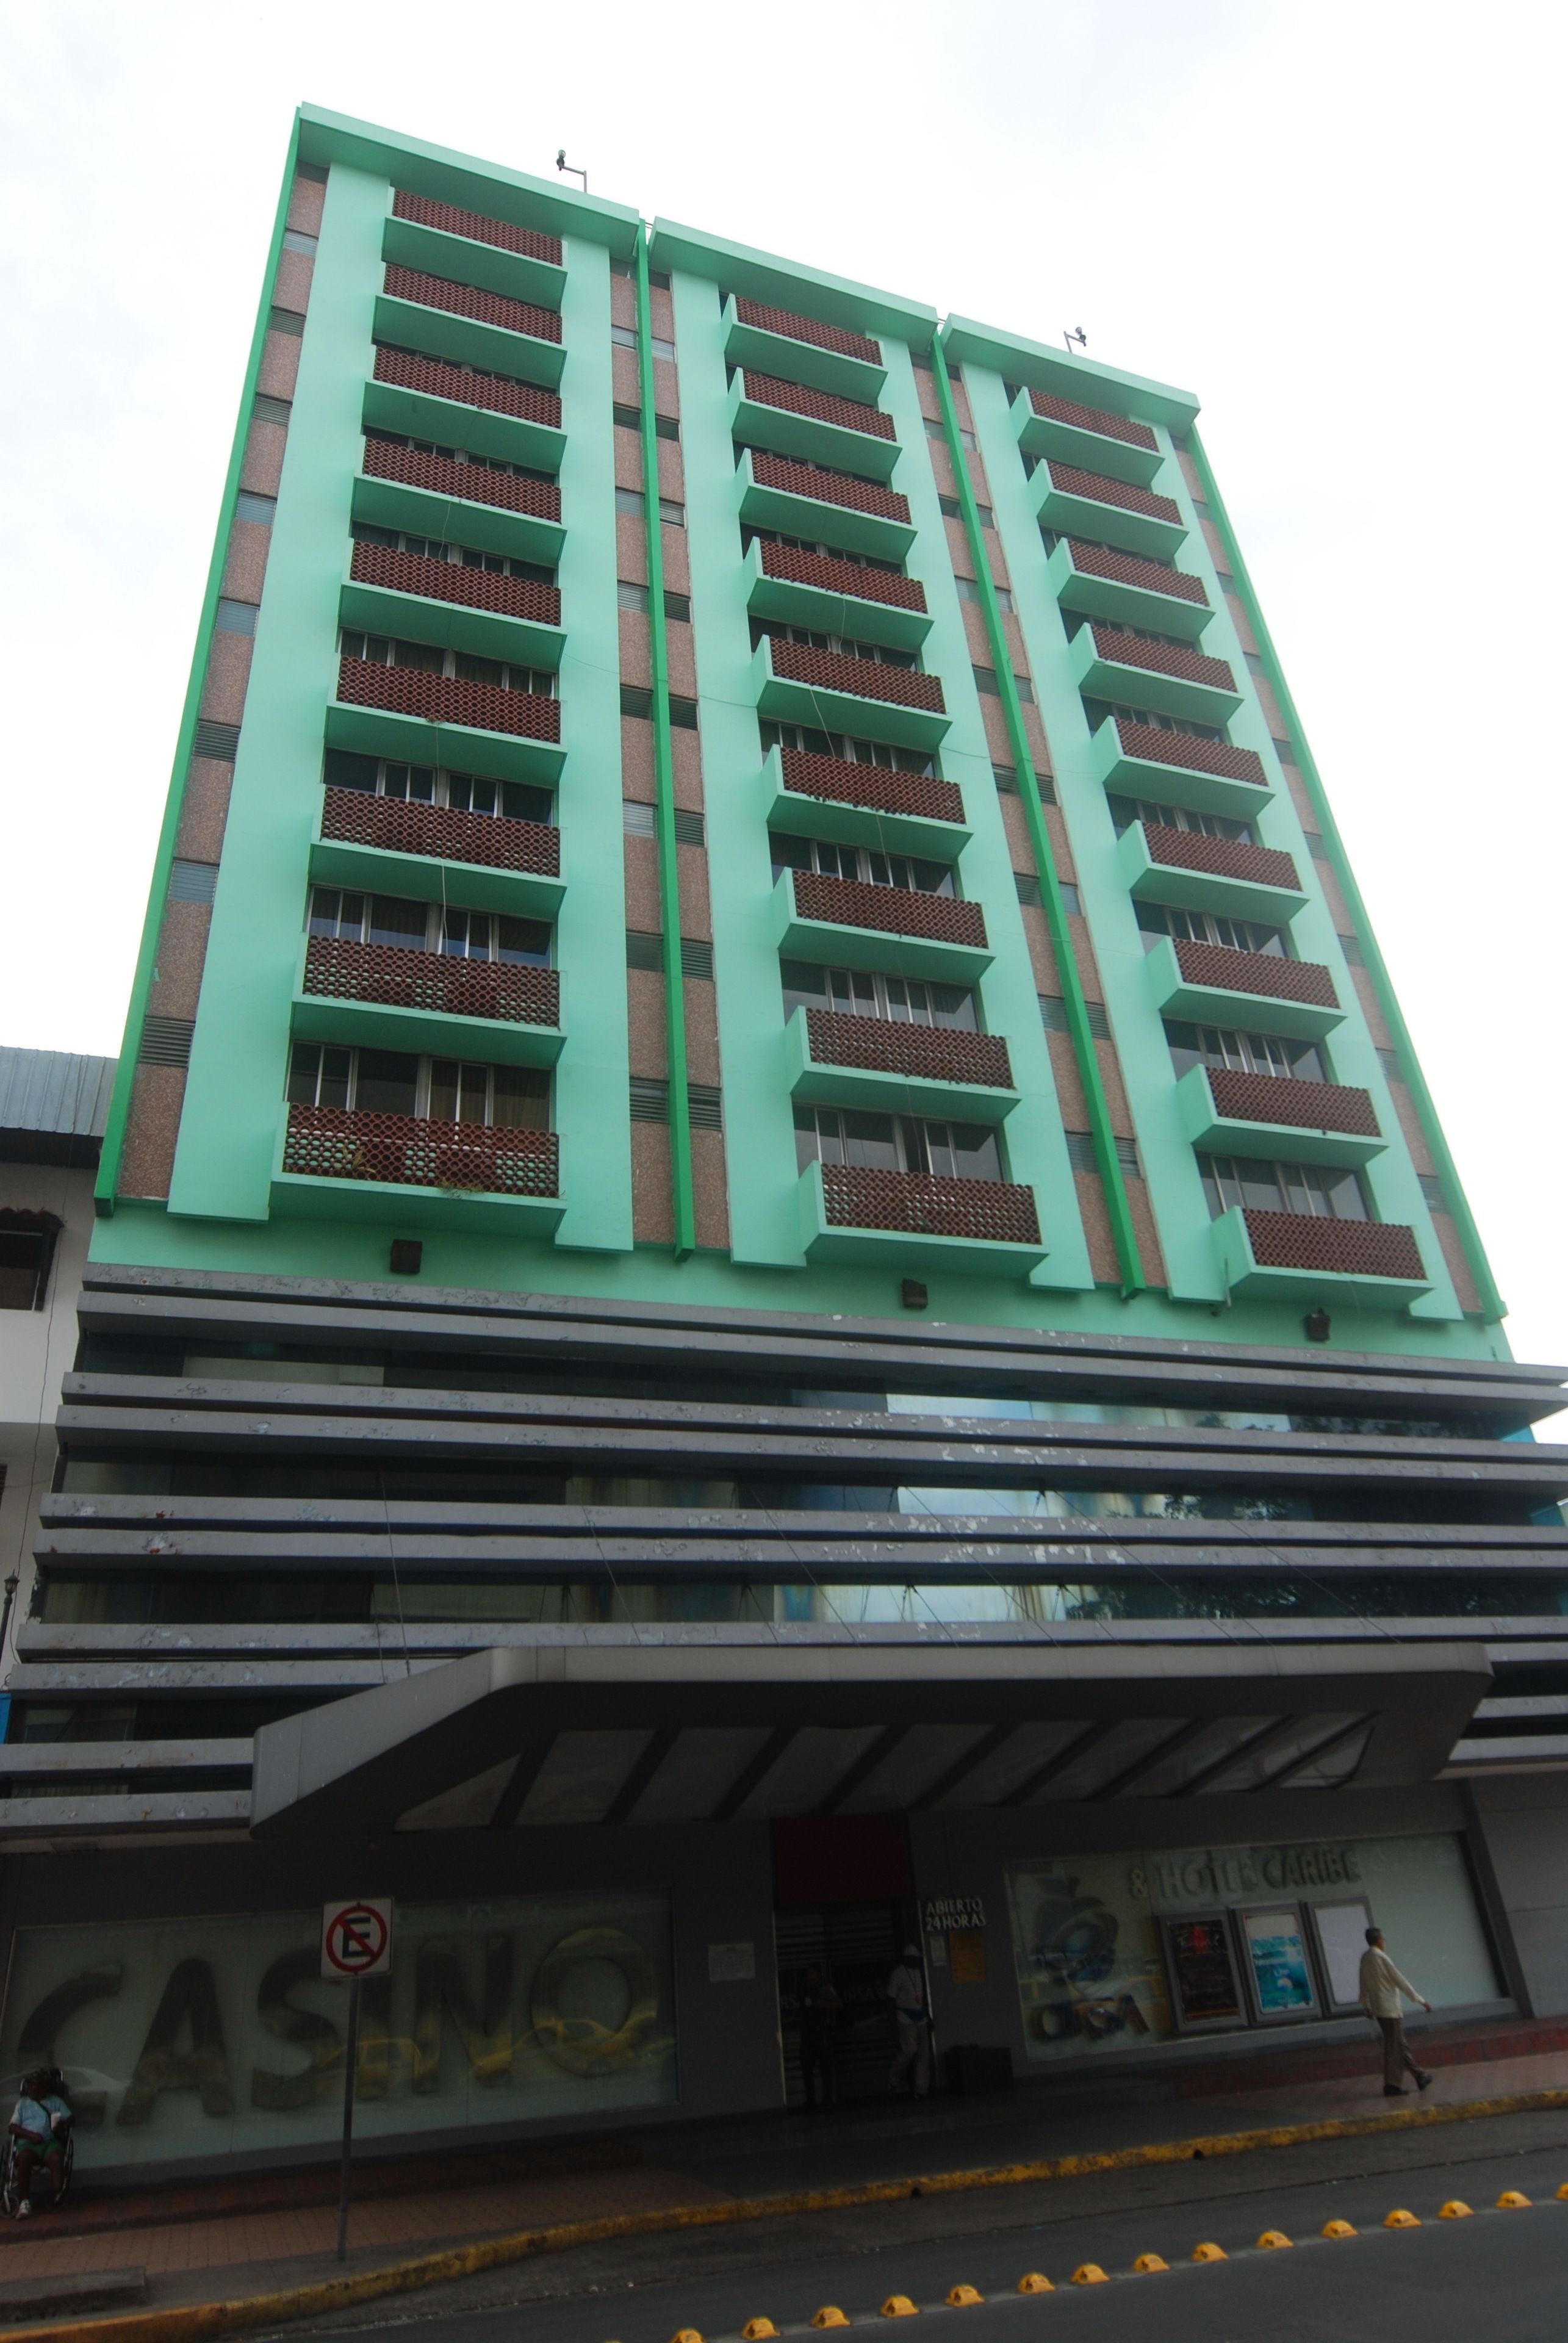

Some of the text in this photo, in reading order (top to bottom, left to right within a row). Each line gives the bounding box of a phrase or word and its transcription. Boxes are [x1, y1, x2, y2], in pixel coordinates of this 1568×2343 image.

[1129, 1848, 1362, 1899] & HOTEL CARIBE
[926, 1913, 987, 1931] 24 HORAS
[927, 1897, 983, 1916] ABIERTO
[343, 1917, 372, 1959] E
[16, 1926, 659, 2128] CASINO
